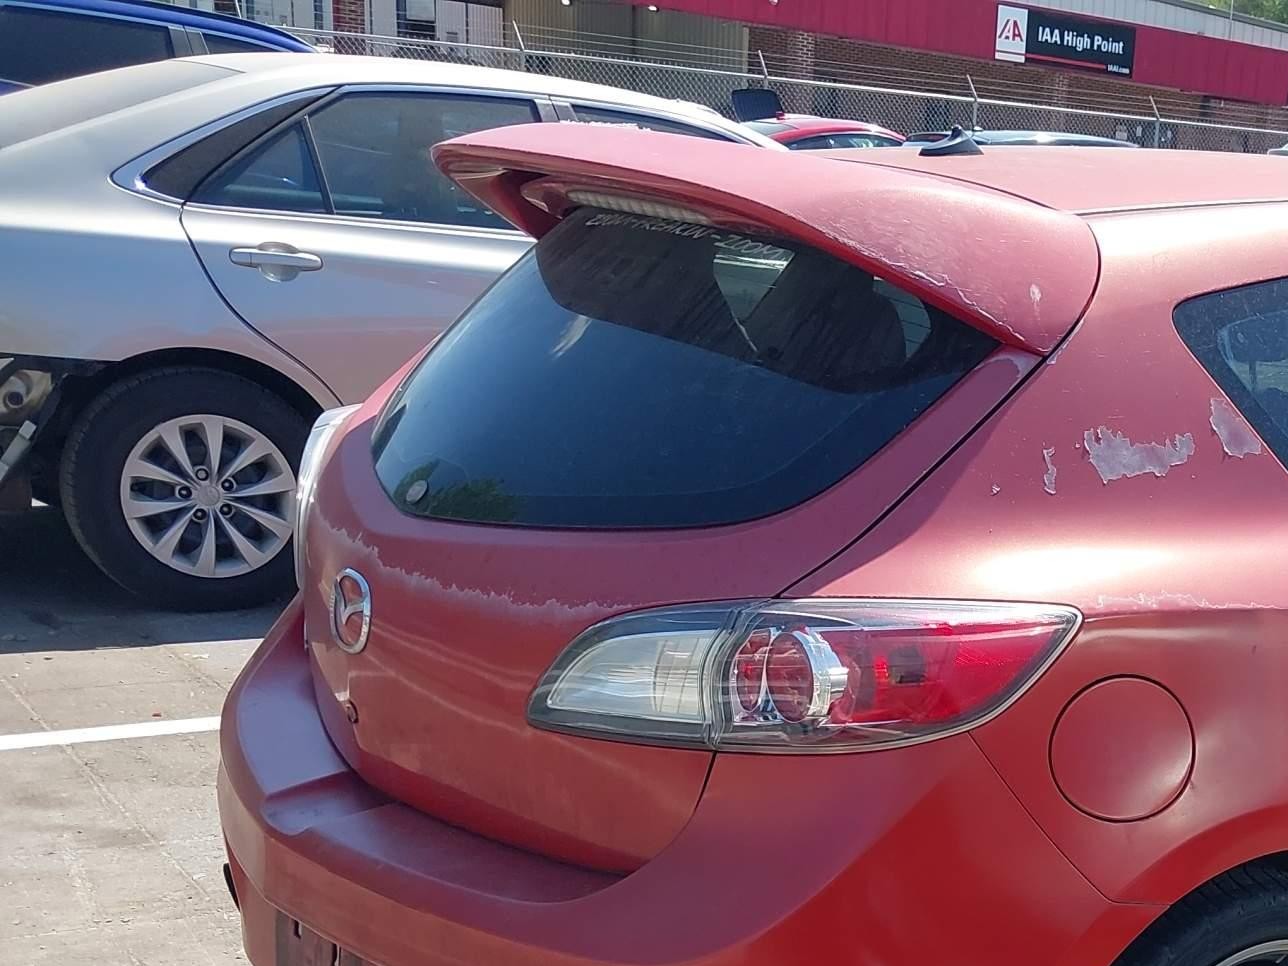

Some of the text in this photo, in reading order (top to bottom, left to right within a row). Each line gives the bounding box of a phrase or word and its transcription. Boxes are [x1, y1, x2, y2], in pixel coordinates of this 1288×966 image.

[1038, 26, 1124, 54] IAA High Point
